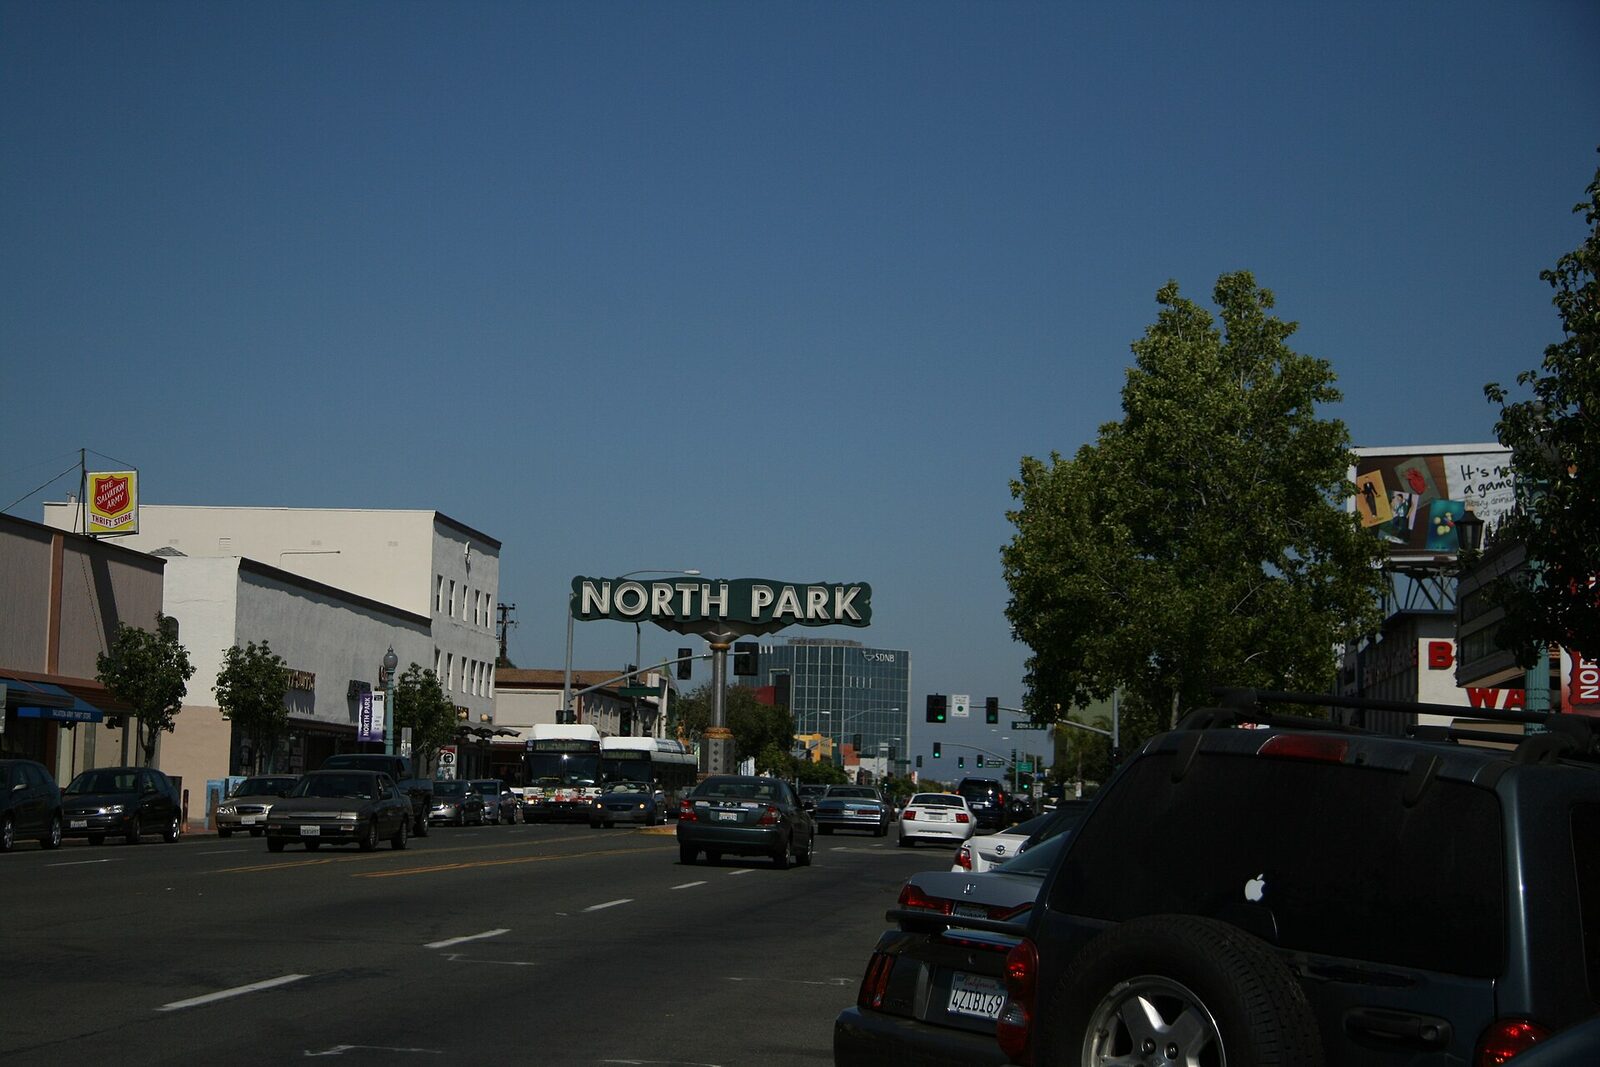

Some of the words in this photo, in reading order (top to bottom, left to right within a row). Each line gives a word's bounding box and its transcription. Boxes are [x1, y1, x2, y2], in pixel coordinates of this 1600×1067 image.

[1461, 464, 1489, 480] It's
[96, 481, 125, 506] SALVATION
[101, 480, 114, 492] THE
[1464, 485, 1474, 494] a
[1478, 479, 1514, 498] game
[106, 492, 124, 509] ARMY
[92, 514, 111, 526] THRIFT
[114, 513, 132, 525] STORE
[581, 580, 729, 617] NORTH
[750, 584, 863, 621] PARK
[1580, 655, 1600, 699] NOR
[363, 697, 371, 714] PARK
[363, 714, 371, 737] NORTH
